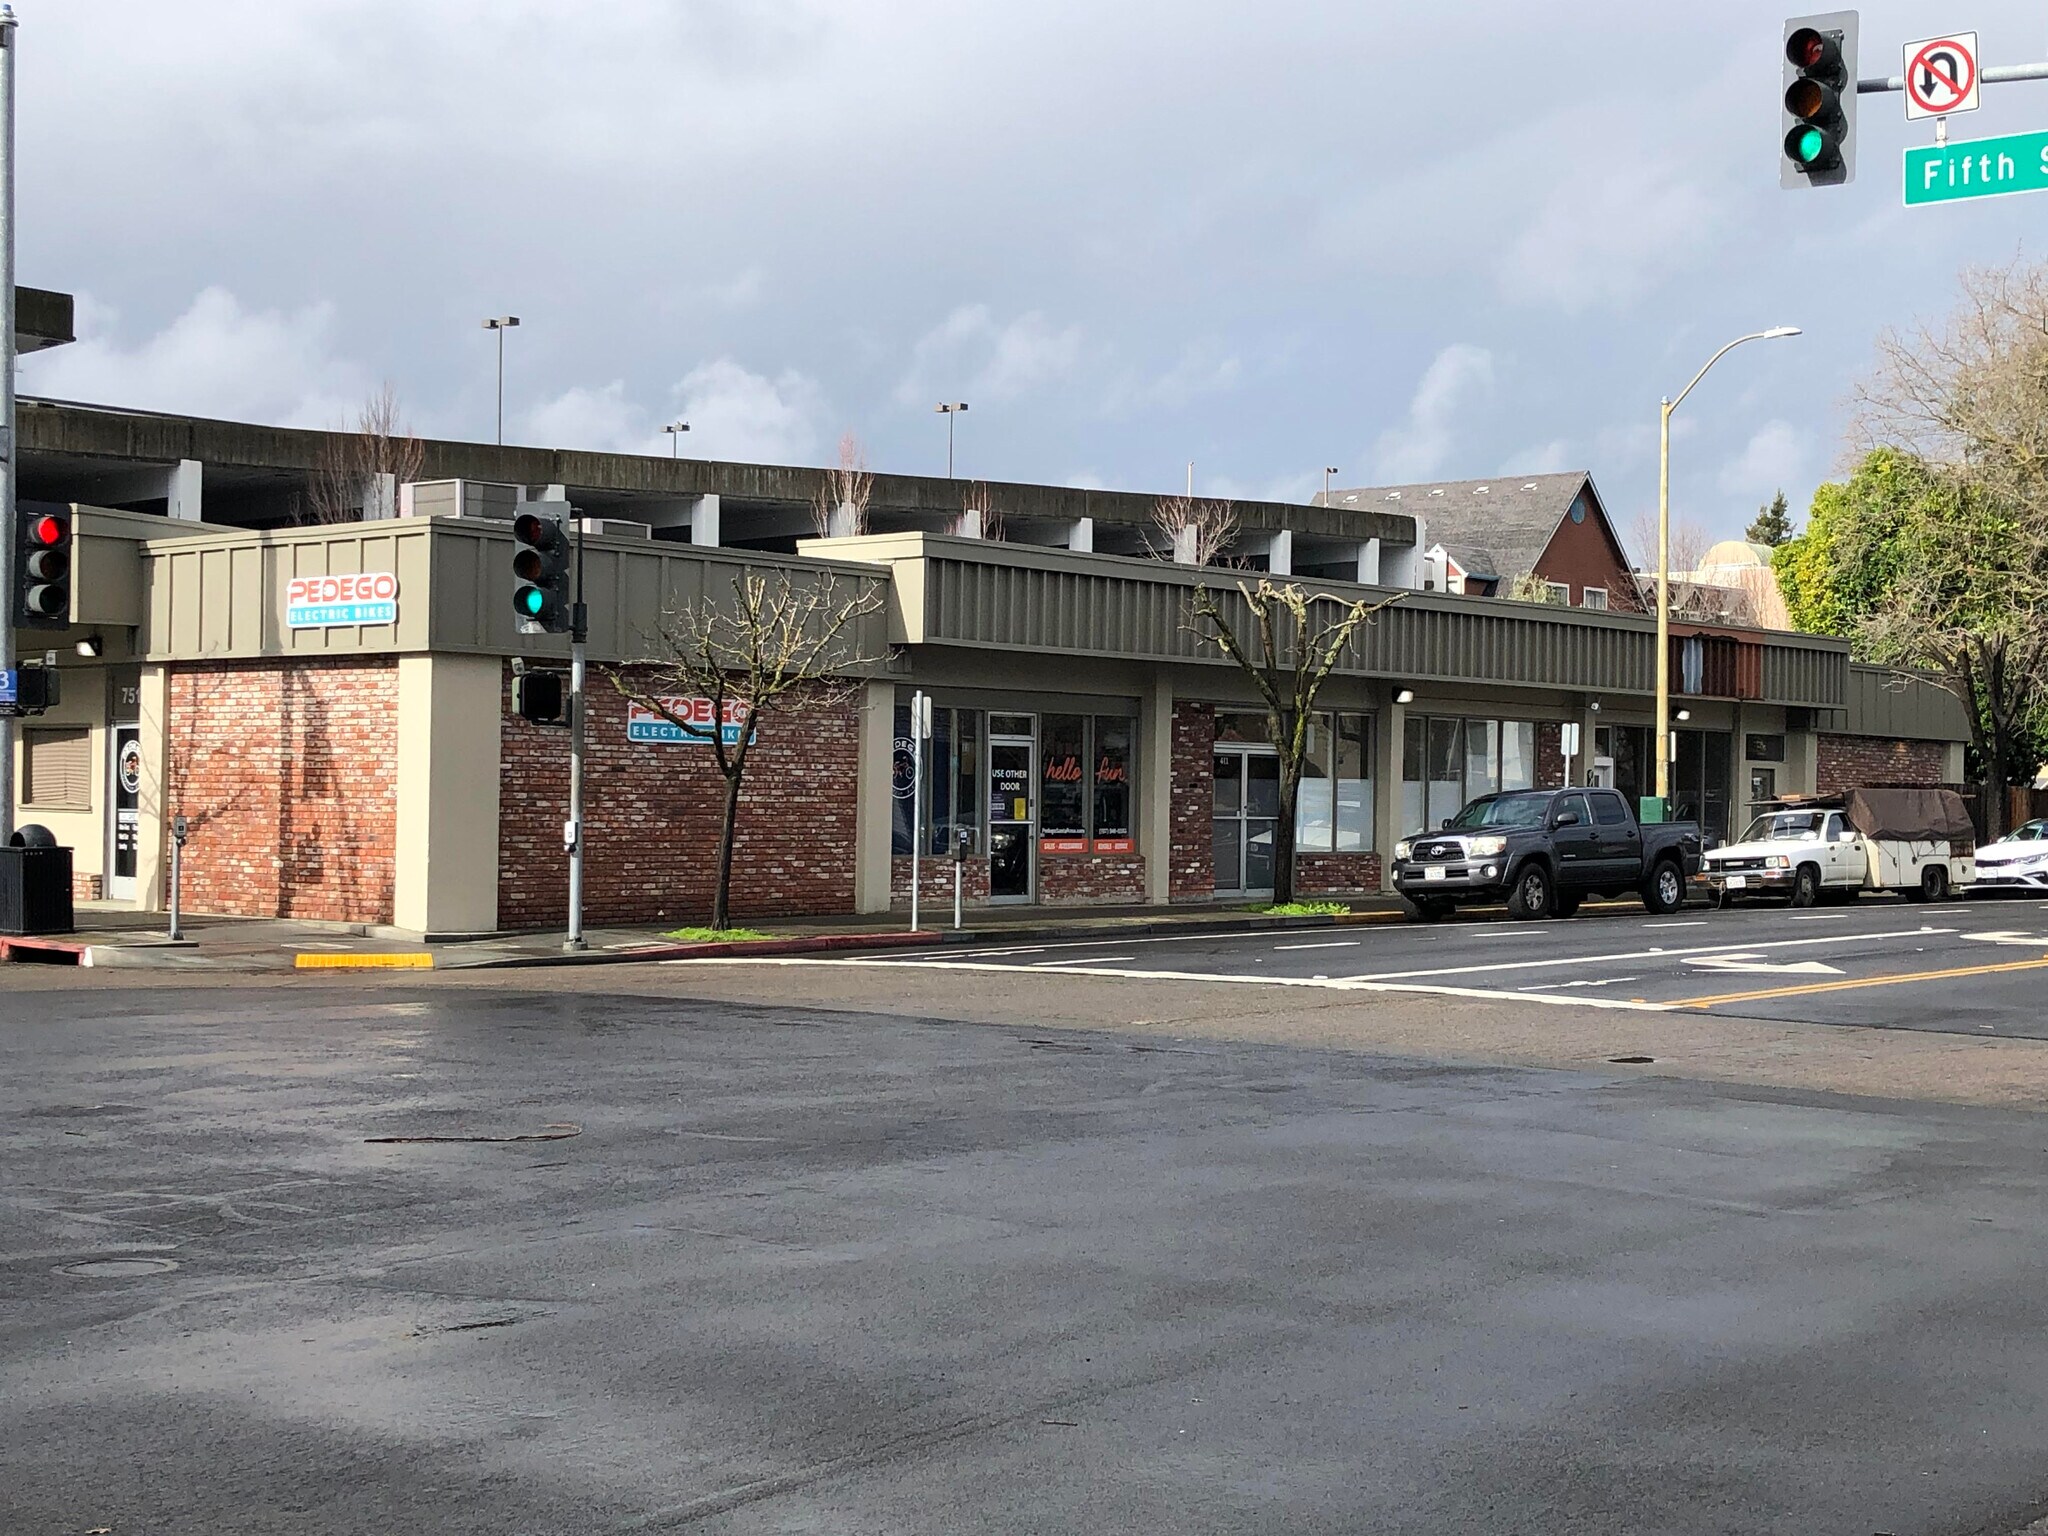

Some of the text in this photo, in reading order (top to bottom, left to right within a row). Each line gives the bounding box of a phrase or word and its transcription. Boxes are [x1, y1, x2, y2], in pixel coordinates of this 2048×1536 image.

[1924, 152, 2015, 189] Fifth
[290, 576, 394, 604] PEDEGO
[290, 606, 392, 622] ELECTRIC BIKES
[633, 725, 703, 739] ELECTR
[992, 769, 1027, 778] USE OTHER
[1000, 782, 1020, 791] DOOR
